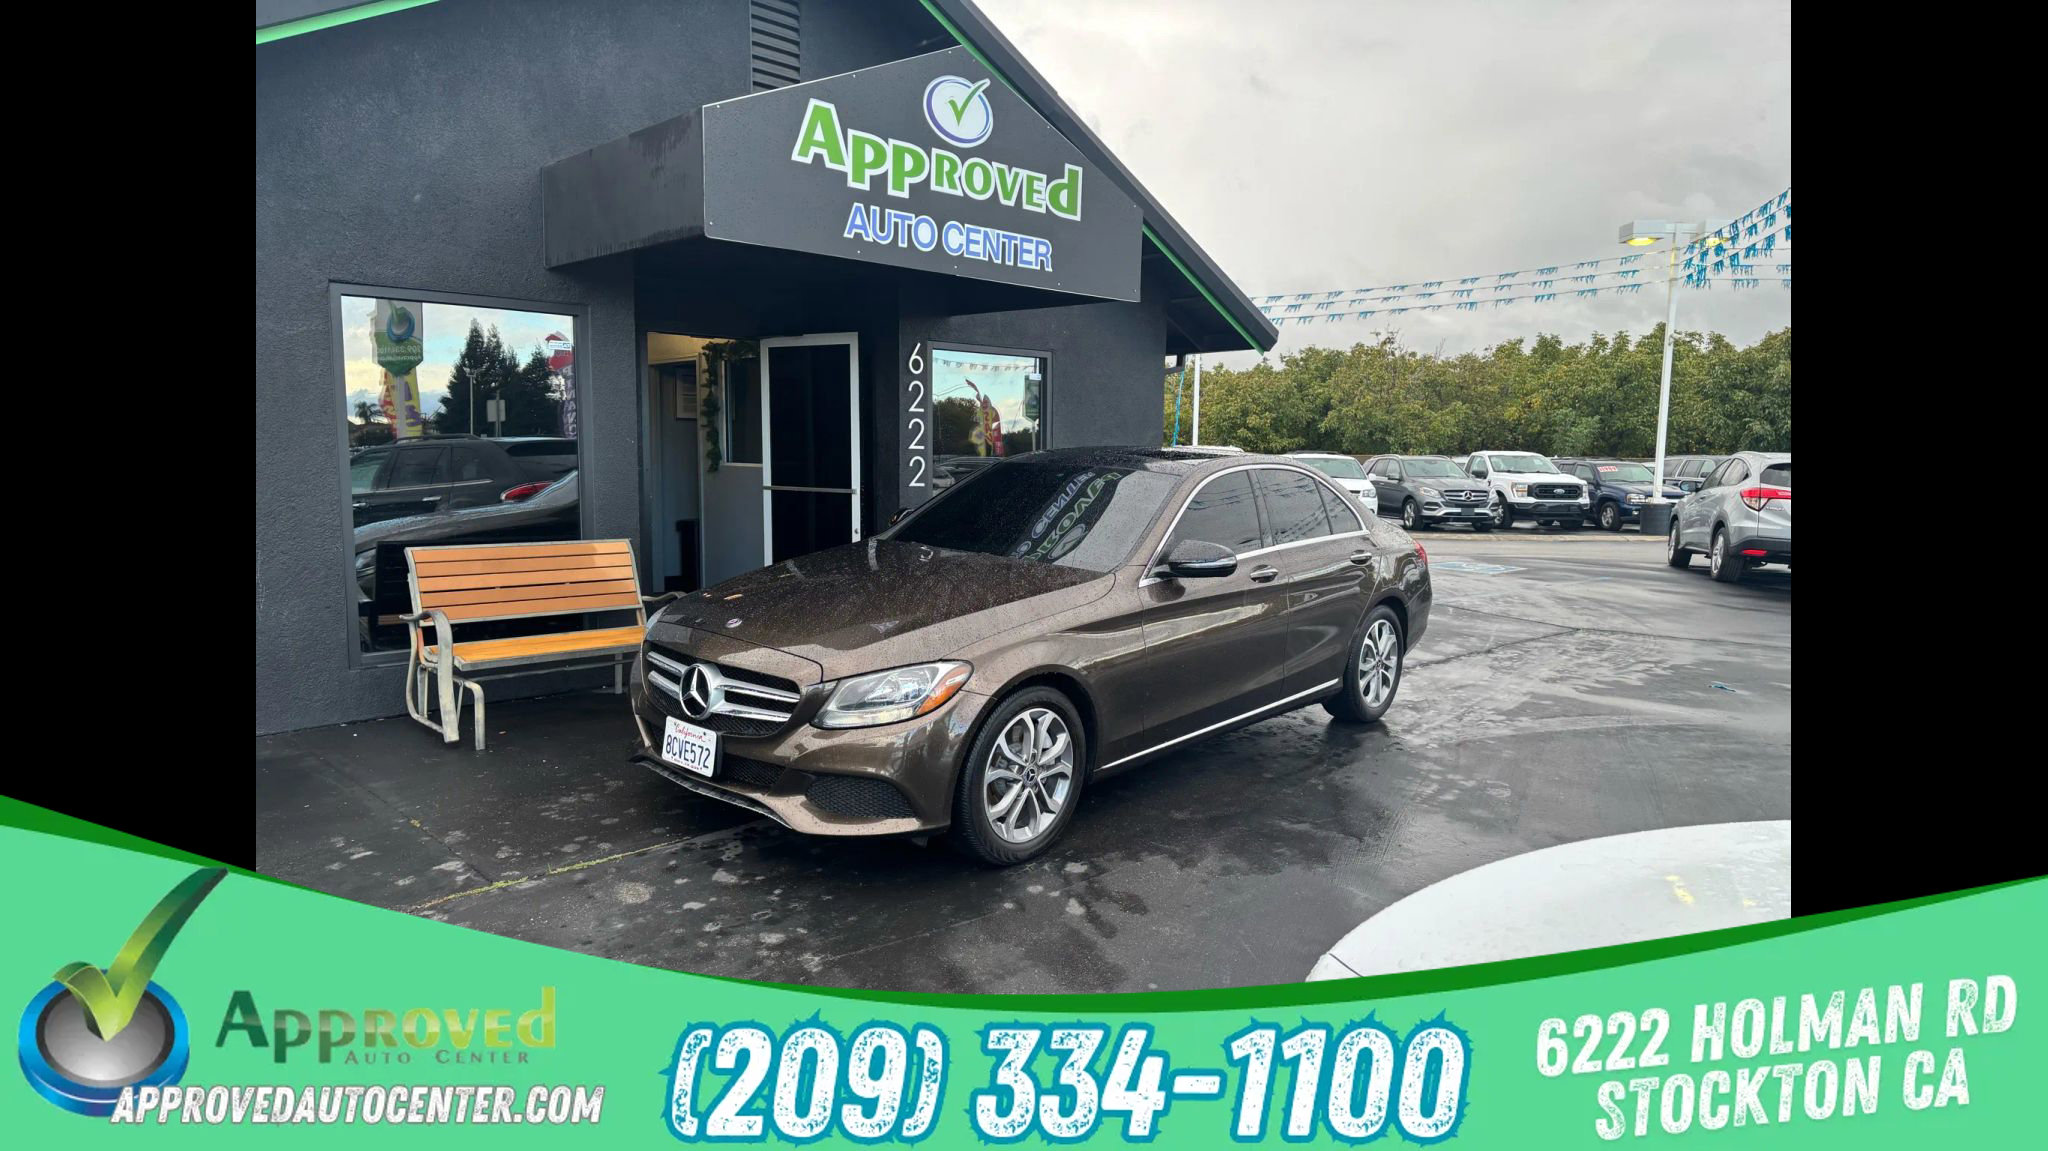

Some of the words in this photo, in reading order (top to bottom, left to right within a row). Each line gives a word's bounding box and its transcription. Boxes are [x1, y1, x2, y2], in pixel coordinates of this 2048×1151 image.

[844, 202, 938, 252] AUTO
[942, 220, 1053, 272] CENTER
[908, 342, 926, 487] 6222
[665, 734, 711, 769] 8CVE572
